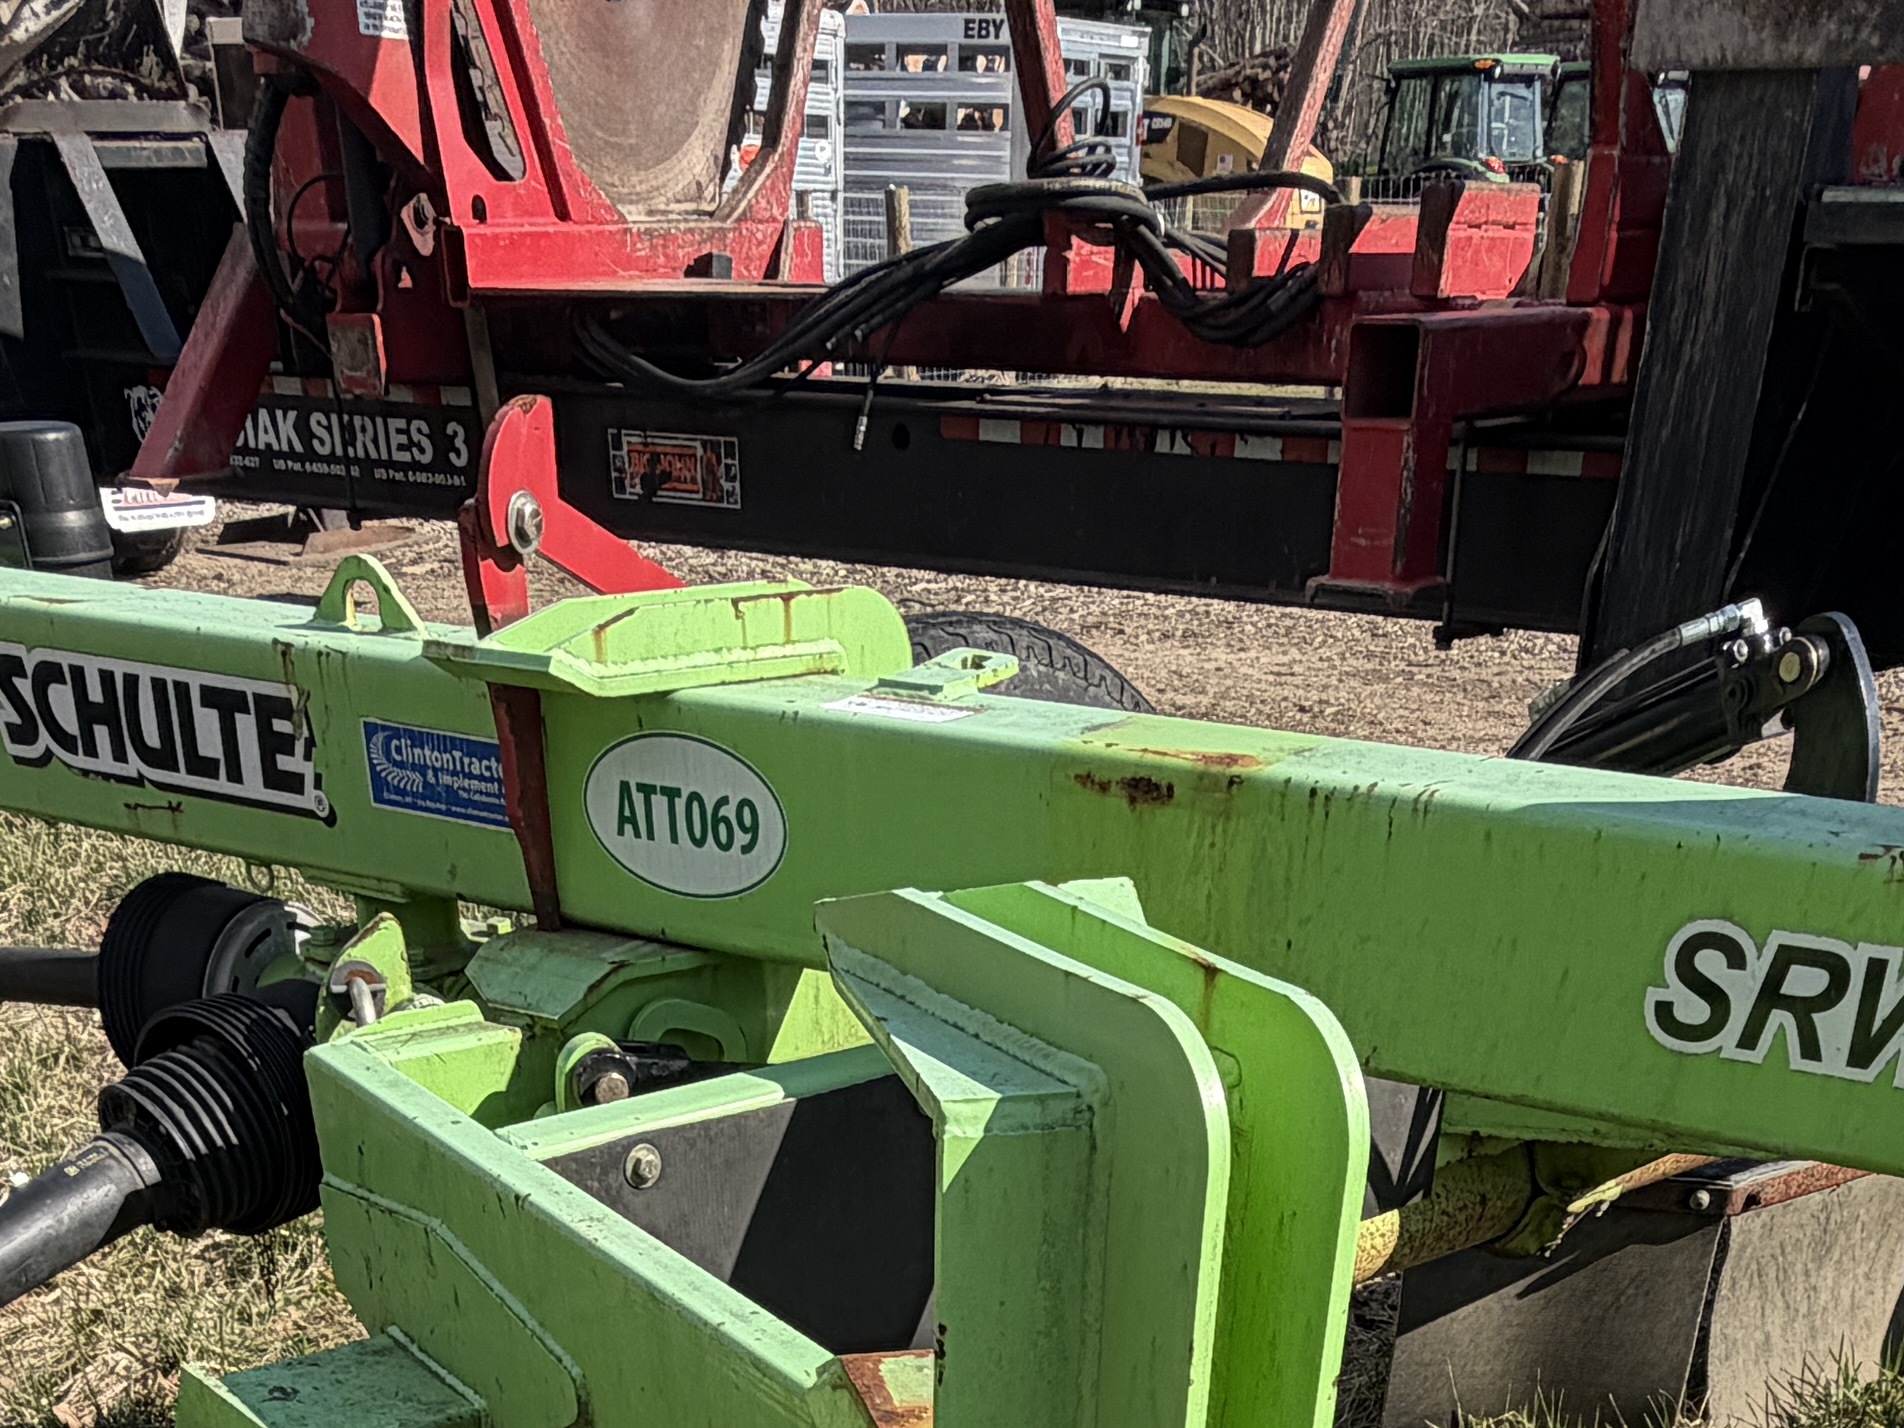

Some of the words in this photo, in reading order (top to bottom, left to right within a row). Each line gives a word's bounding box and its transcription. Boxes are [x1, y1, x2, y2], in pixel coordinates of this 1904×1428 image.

[963, 18, 1005, 40] EBY
[235, 407, 304, 454] IAK
[309, 411, 434, 465] SERIES
[446, 420, 469, 468] 3
[617, 780, 760, 855] ATT069
